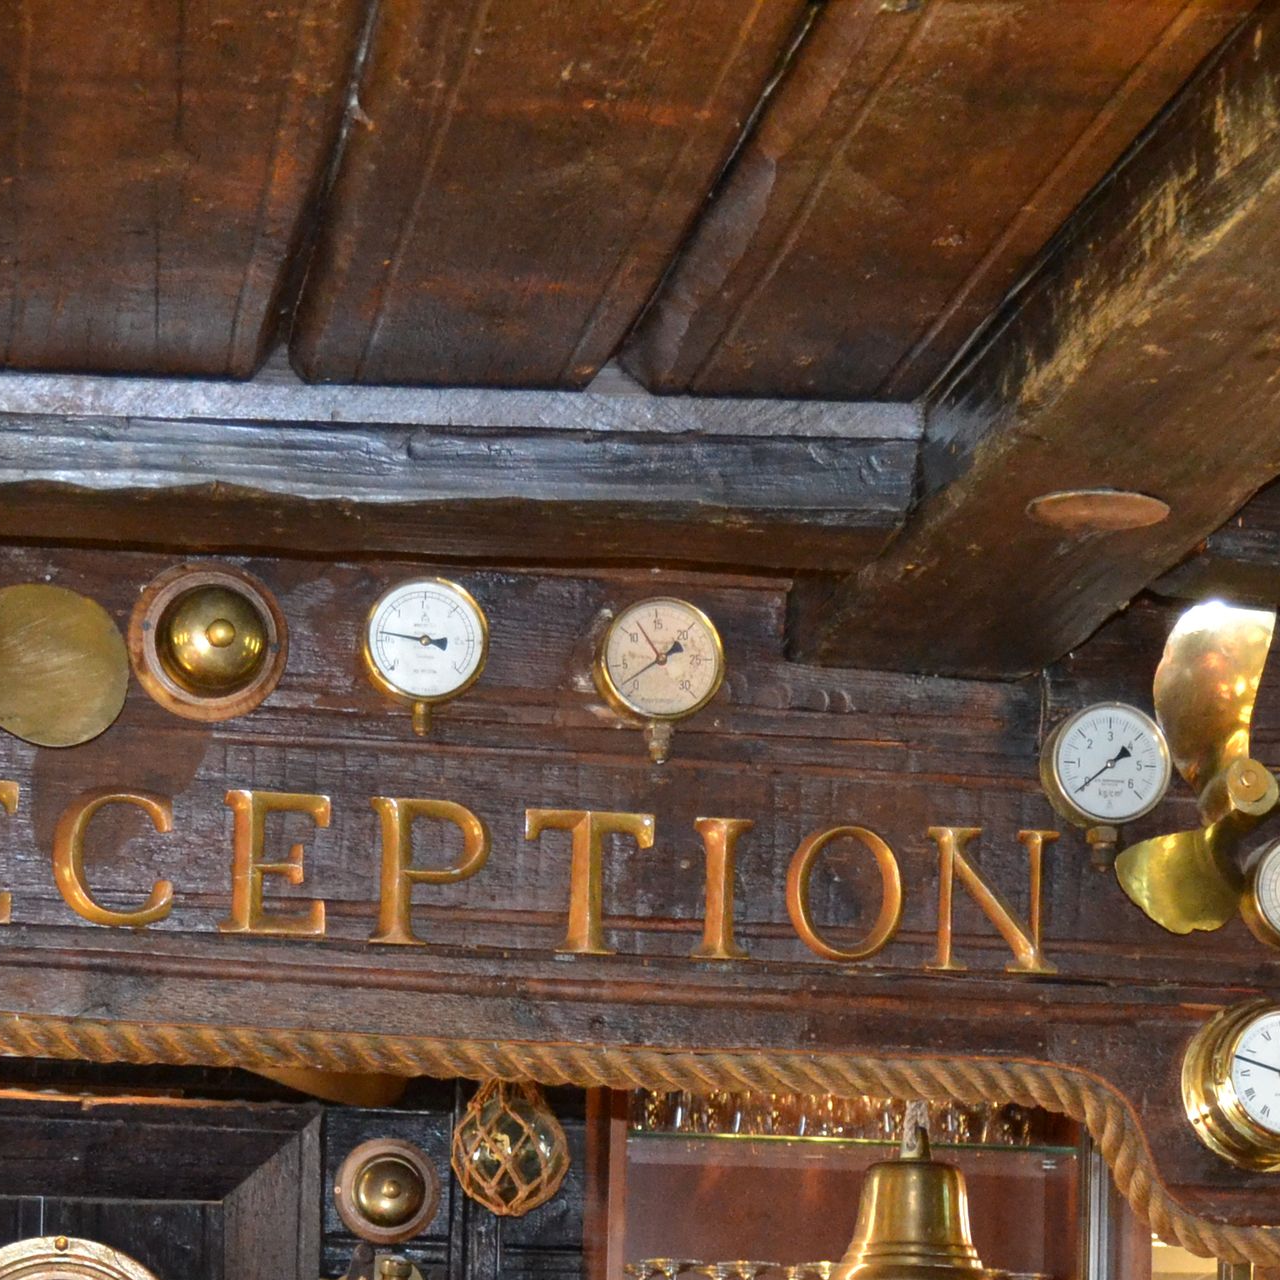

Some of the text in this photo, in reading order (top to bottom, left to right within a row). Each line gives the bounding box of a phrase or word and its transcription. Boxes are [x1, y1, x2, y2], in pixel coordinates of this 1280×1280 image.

[653, 620, 662, 630] 15
[629, 633, 638, 642] 10
[677, 630, 688, 640] 20
[622, 660, 628, 669] 5
[689, 655, 701, 666] 25
[679, 680, 690, 690] 30
[1107, 731, 1113, 742] 3
[1087, 739, 1093, 750] 2
[1136, 760, 1142, 771] 5
[1128, 779, 1134, 789] 6
